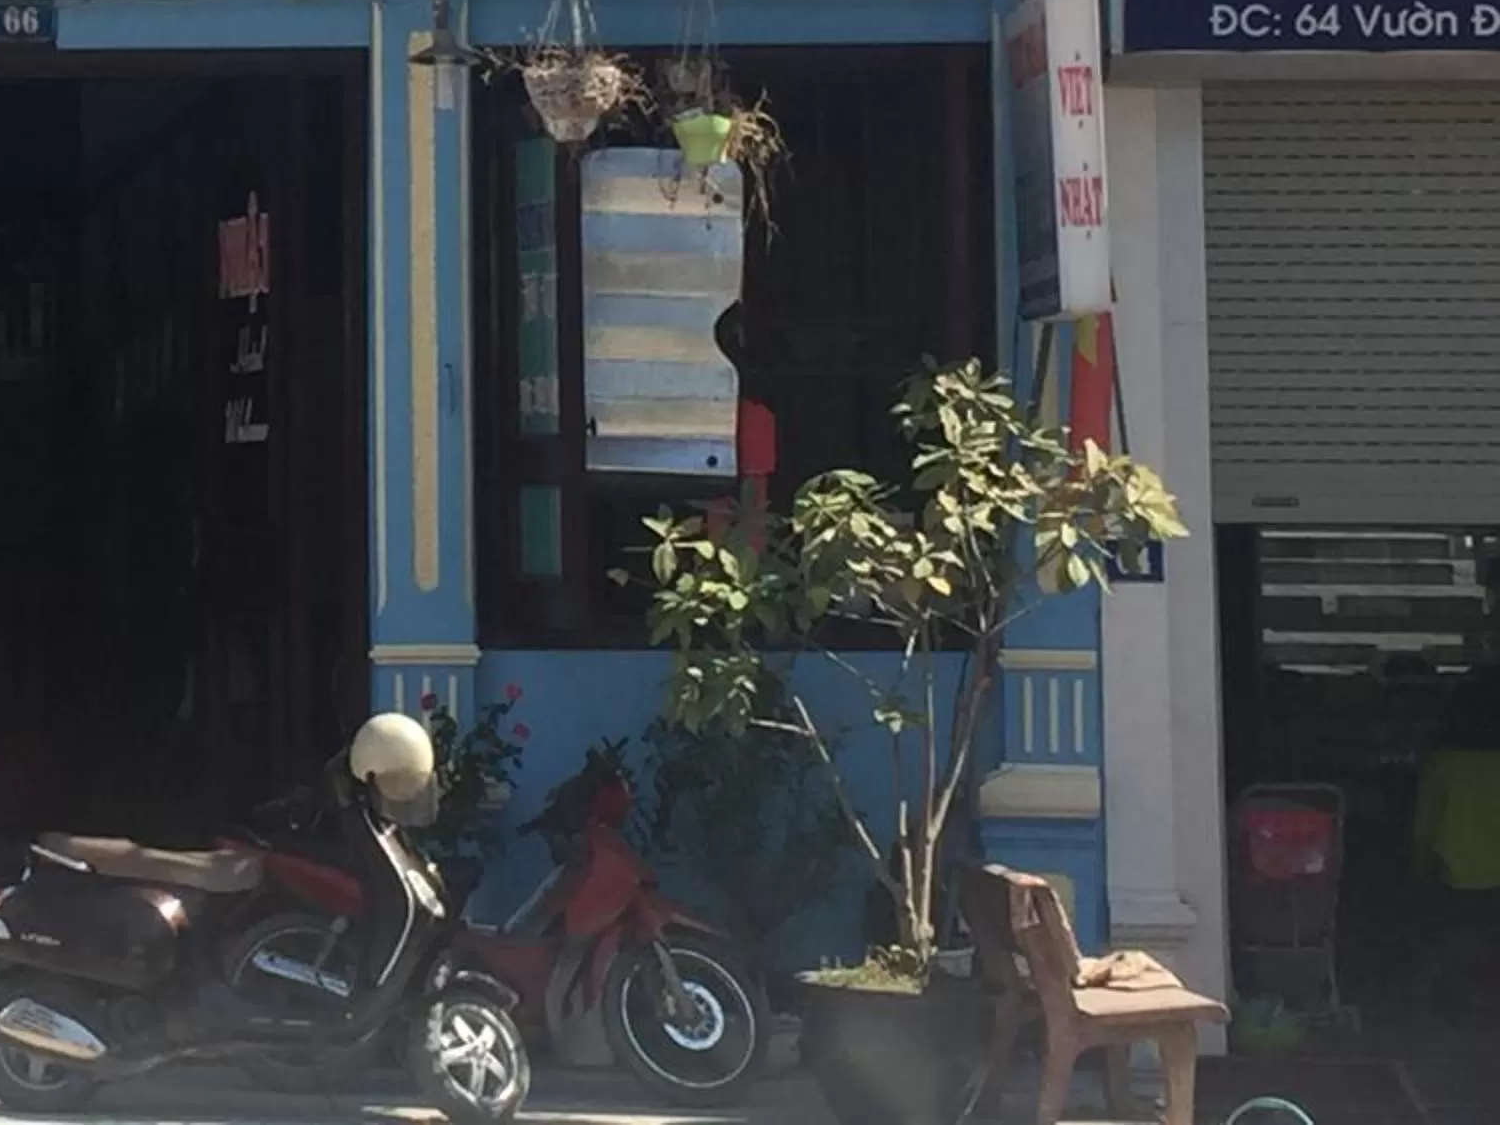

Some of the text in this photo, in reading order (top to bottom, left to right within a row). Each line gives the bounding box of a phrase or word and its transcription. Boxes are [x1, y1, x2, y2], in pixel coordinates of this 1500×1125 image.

[4, 5, 38, 35] 66
[1209, 4, 1282, 36] ĐC:
[1295, 4, 1340, 36] 64
[1353, 0, 1457, 36] Vườn
